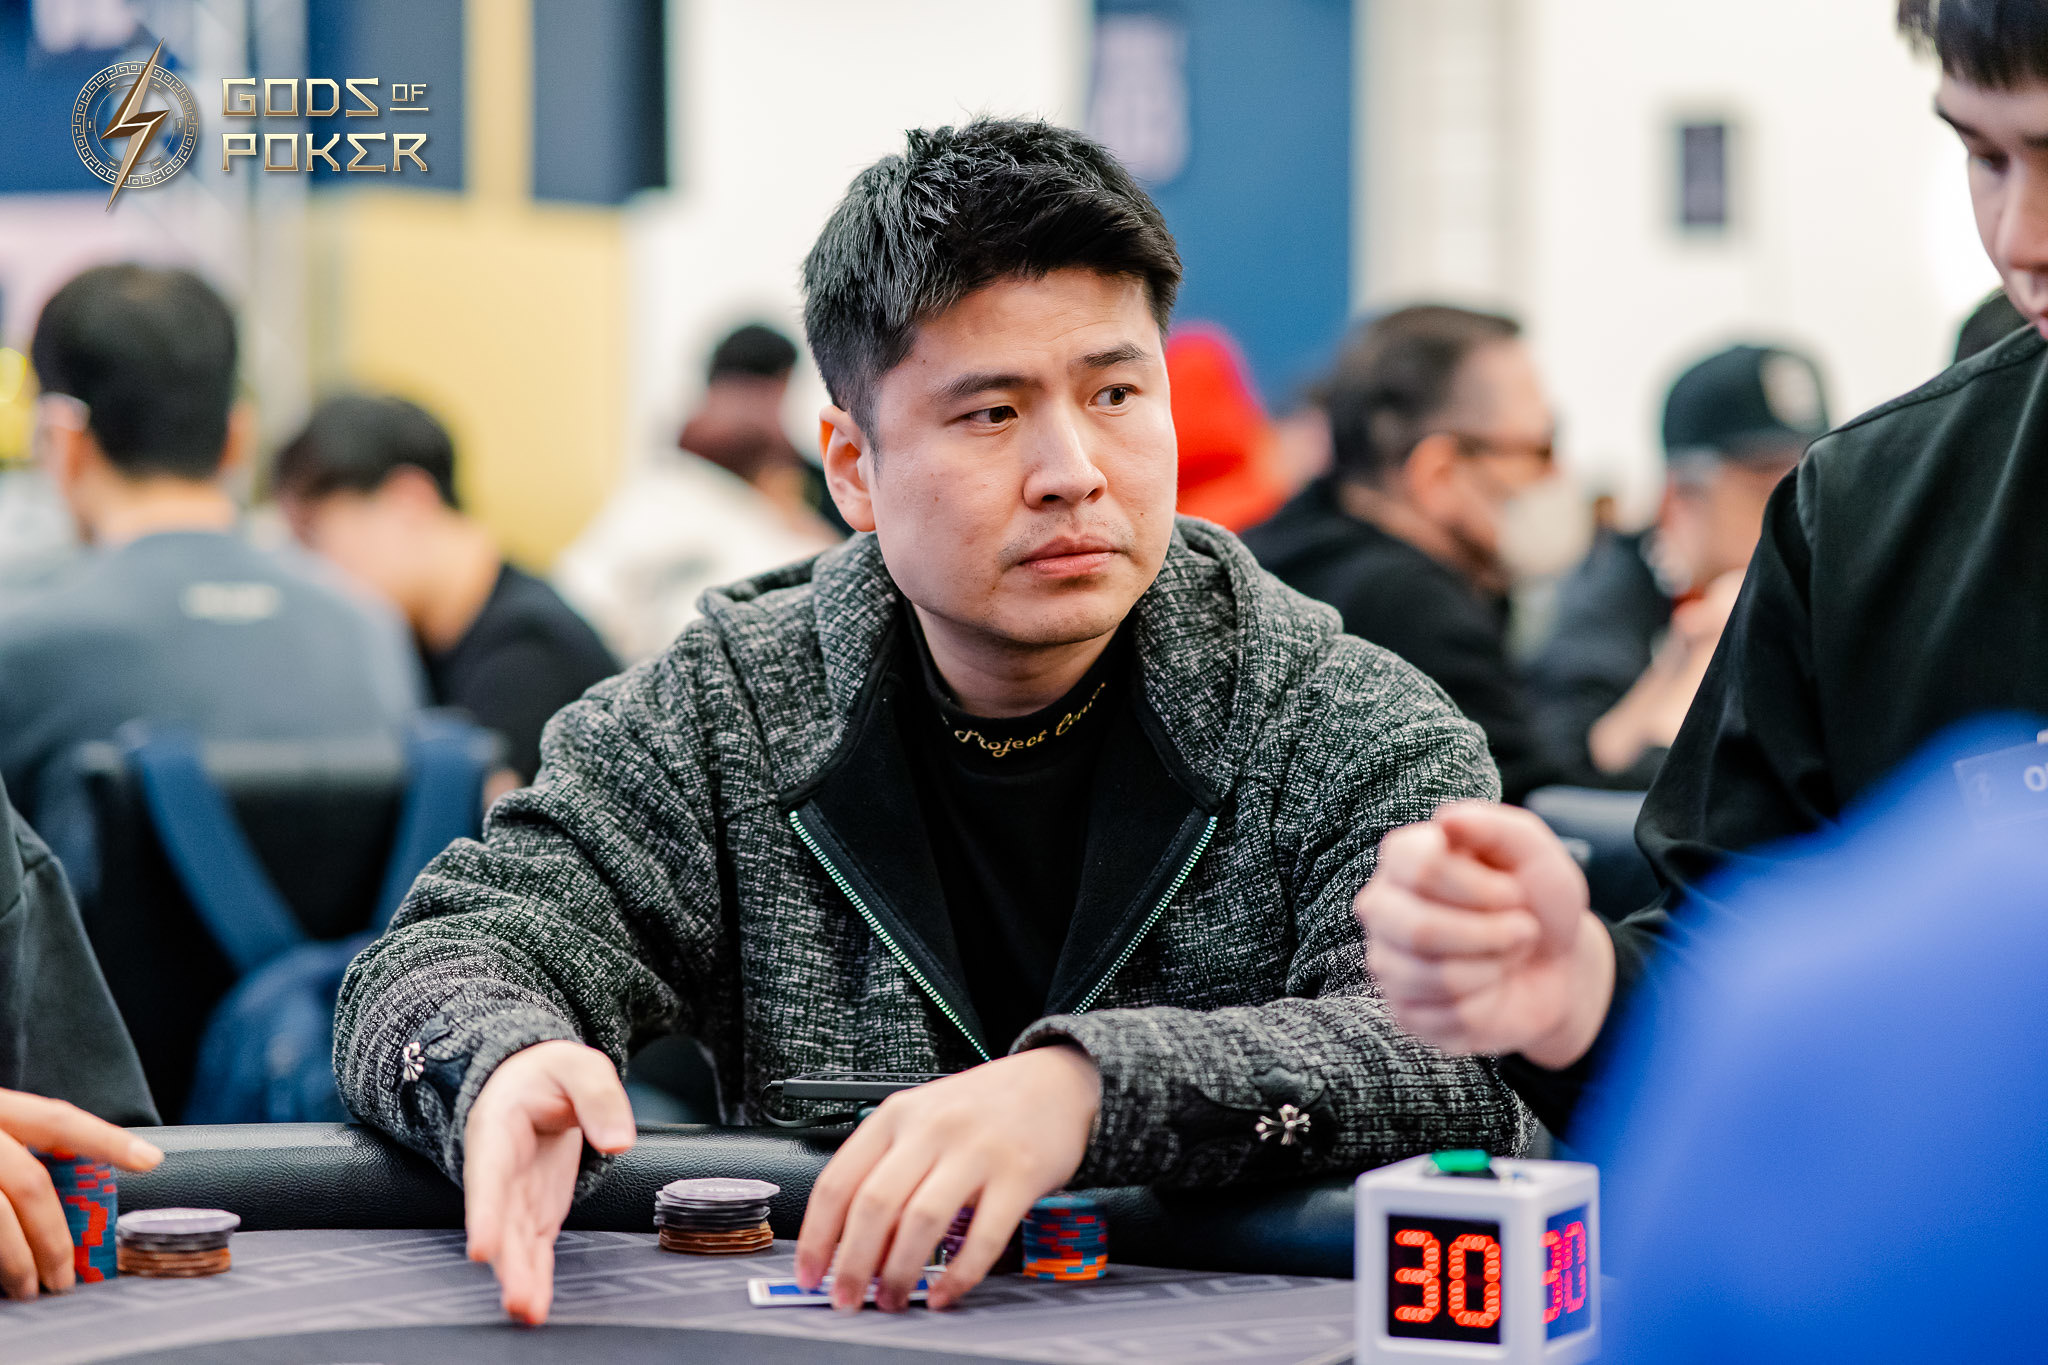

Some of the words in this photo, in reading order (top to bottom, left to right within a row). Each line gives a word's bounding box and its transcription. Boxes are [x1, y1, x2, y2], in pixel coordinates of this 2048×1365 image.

[954, 729, 1048, 758] Project
[1394, 1229, 1501, 1328] 30
[1540, 1221, 1587, 1324] 30
